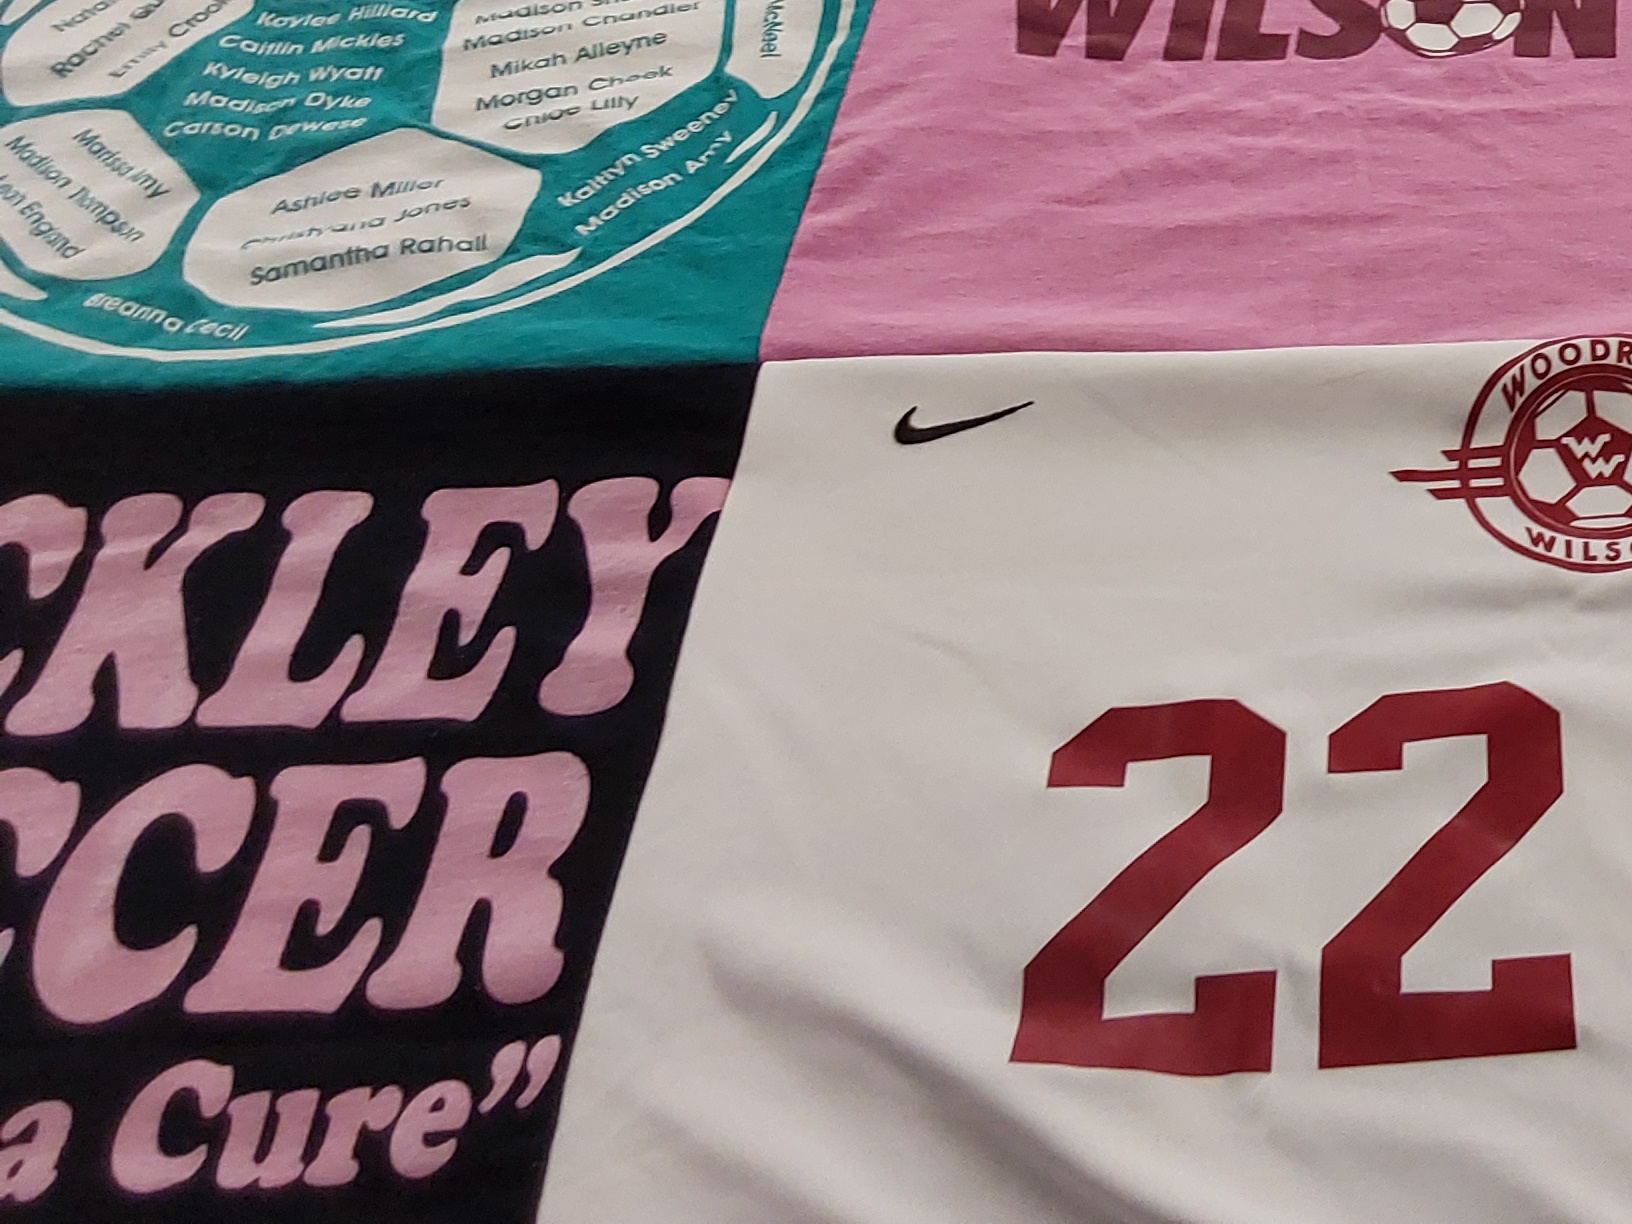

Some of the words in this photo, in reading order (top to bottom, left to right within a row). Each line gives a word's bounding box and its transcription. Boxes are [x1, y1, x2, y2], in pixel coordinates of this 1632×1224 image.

[347, 3, 440, 25] Hilliard
[47, 19, 131, 79] Rachel
[218, 32, 305, 57] Caitlin
[202, 60, 302, 89] Kyleigh
[307, 64, 386, 84] Wyatt
[489, 52, 568, 79] Mikah
[182, 90, 298, 115] Madison
[303, 90, 374, 111] Dyke
[475, 84, 579, 111] Morgan
[640, 88, 738, 160] Sweeney
[5, 134, 73, 190] Madison
[269, 186, 362, 216] Ashlee
[368, 177, 448, 199] Miller
[393, 194, 473, 223] Jones
[574, 171, 684, 236] Madison
[249, 243, 393, 287] Samantha
[399, 233, 489, 258] Rahall
[1009, 681, 1577, 1078] 22
[0, 1099, 74, 1204] a
